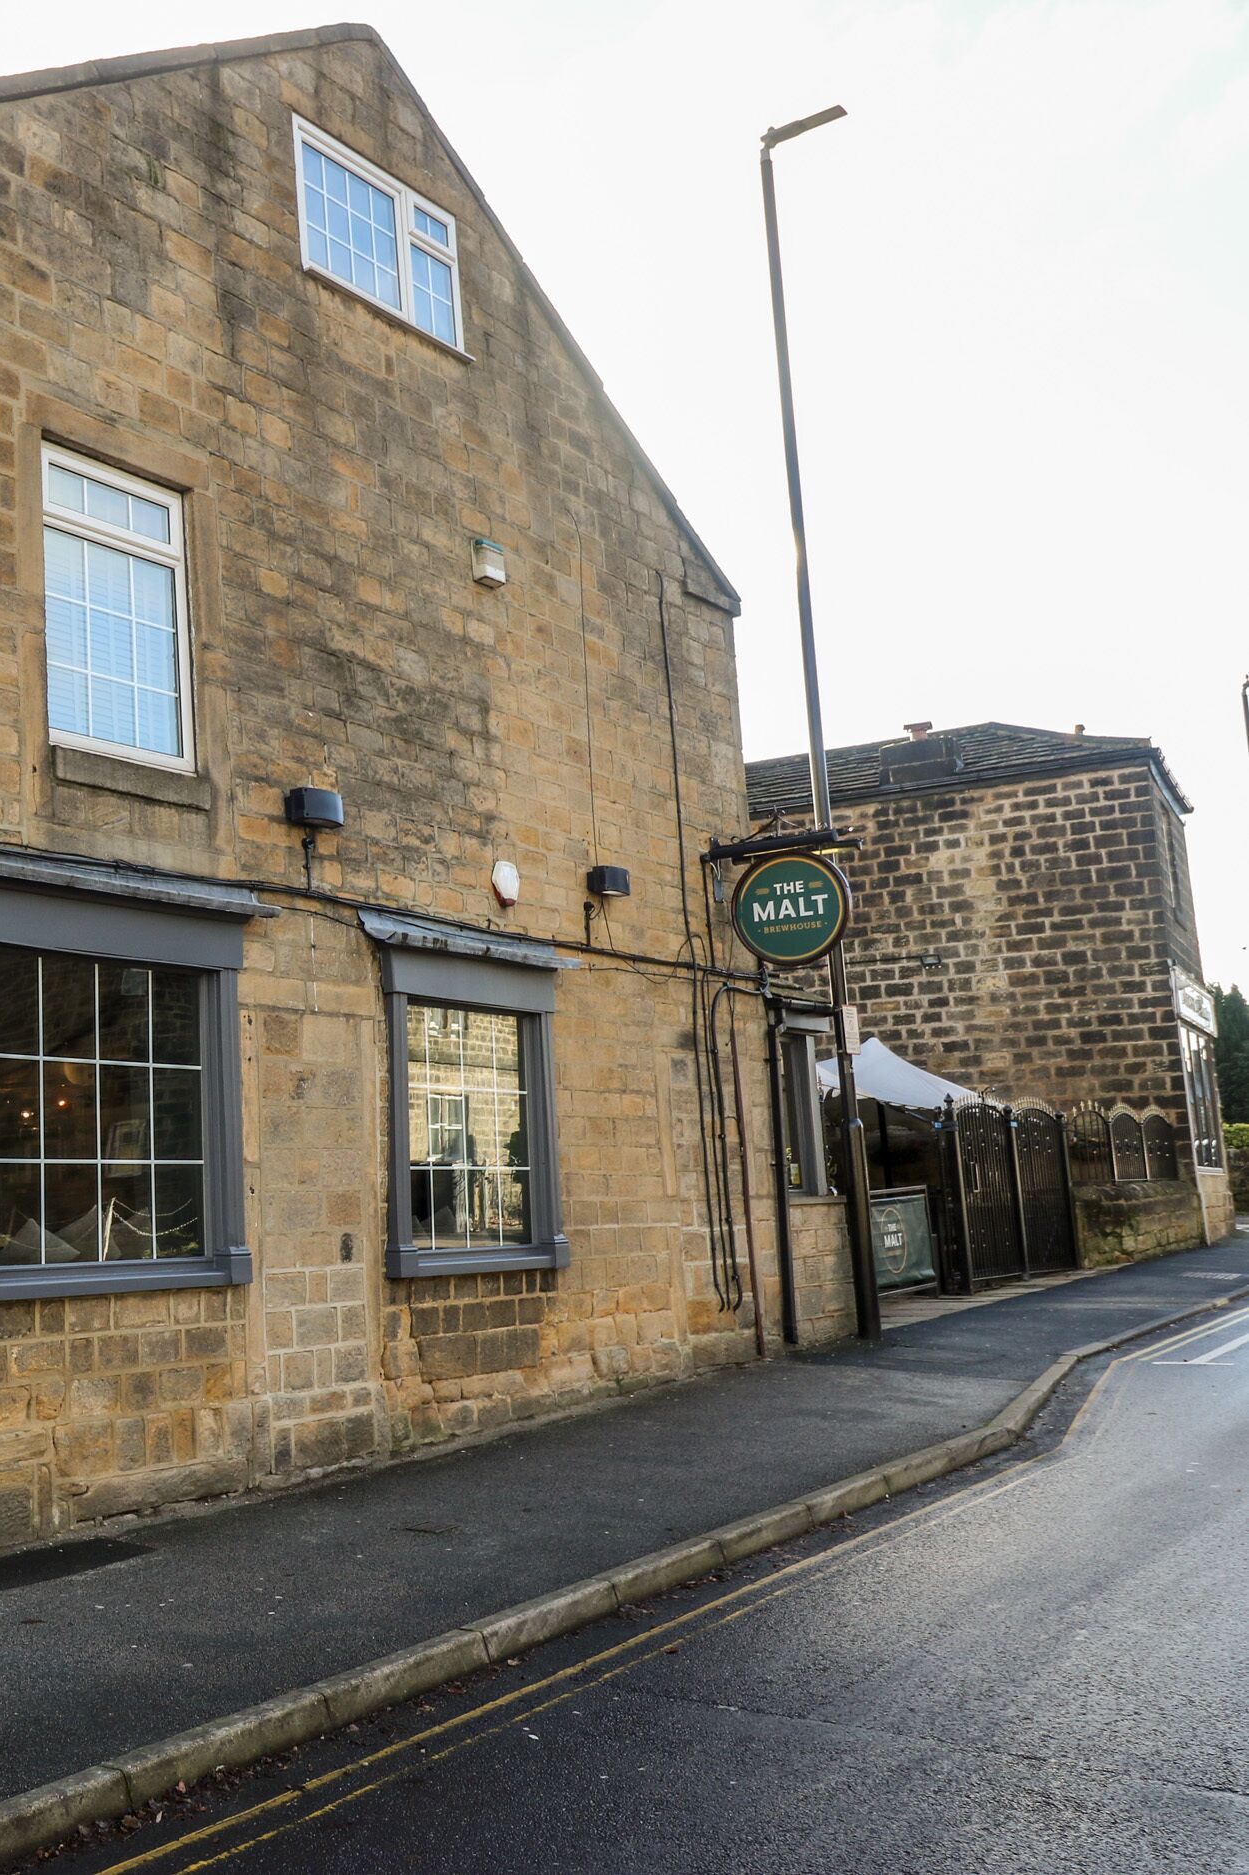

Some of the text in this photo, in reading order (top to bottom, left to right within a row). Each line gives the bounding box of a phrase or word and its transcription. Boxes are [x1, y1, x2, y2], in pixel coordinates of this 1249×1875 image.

[773, 880, 805, 896] THE
[752, 894, 829, 923] MALT
[763, 920, 823, 935] BREWHOUSE
[884, 1233, 902, 1248] MALT
